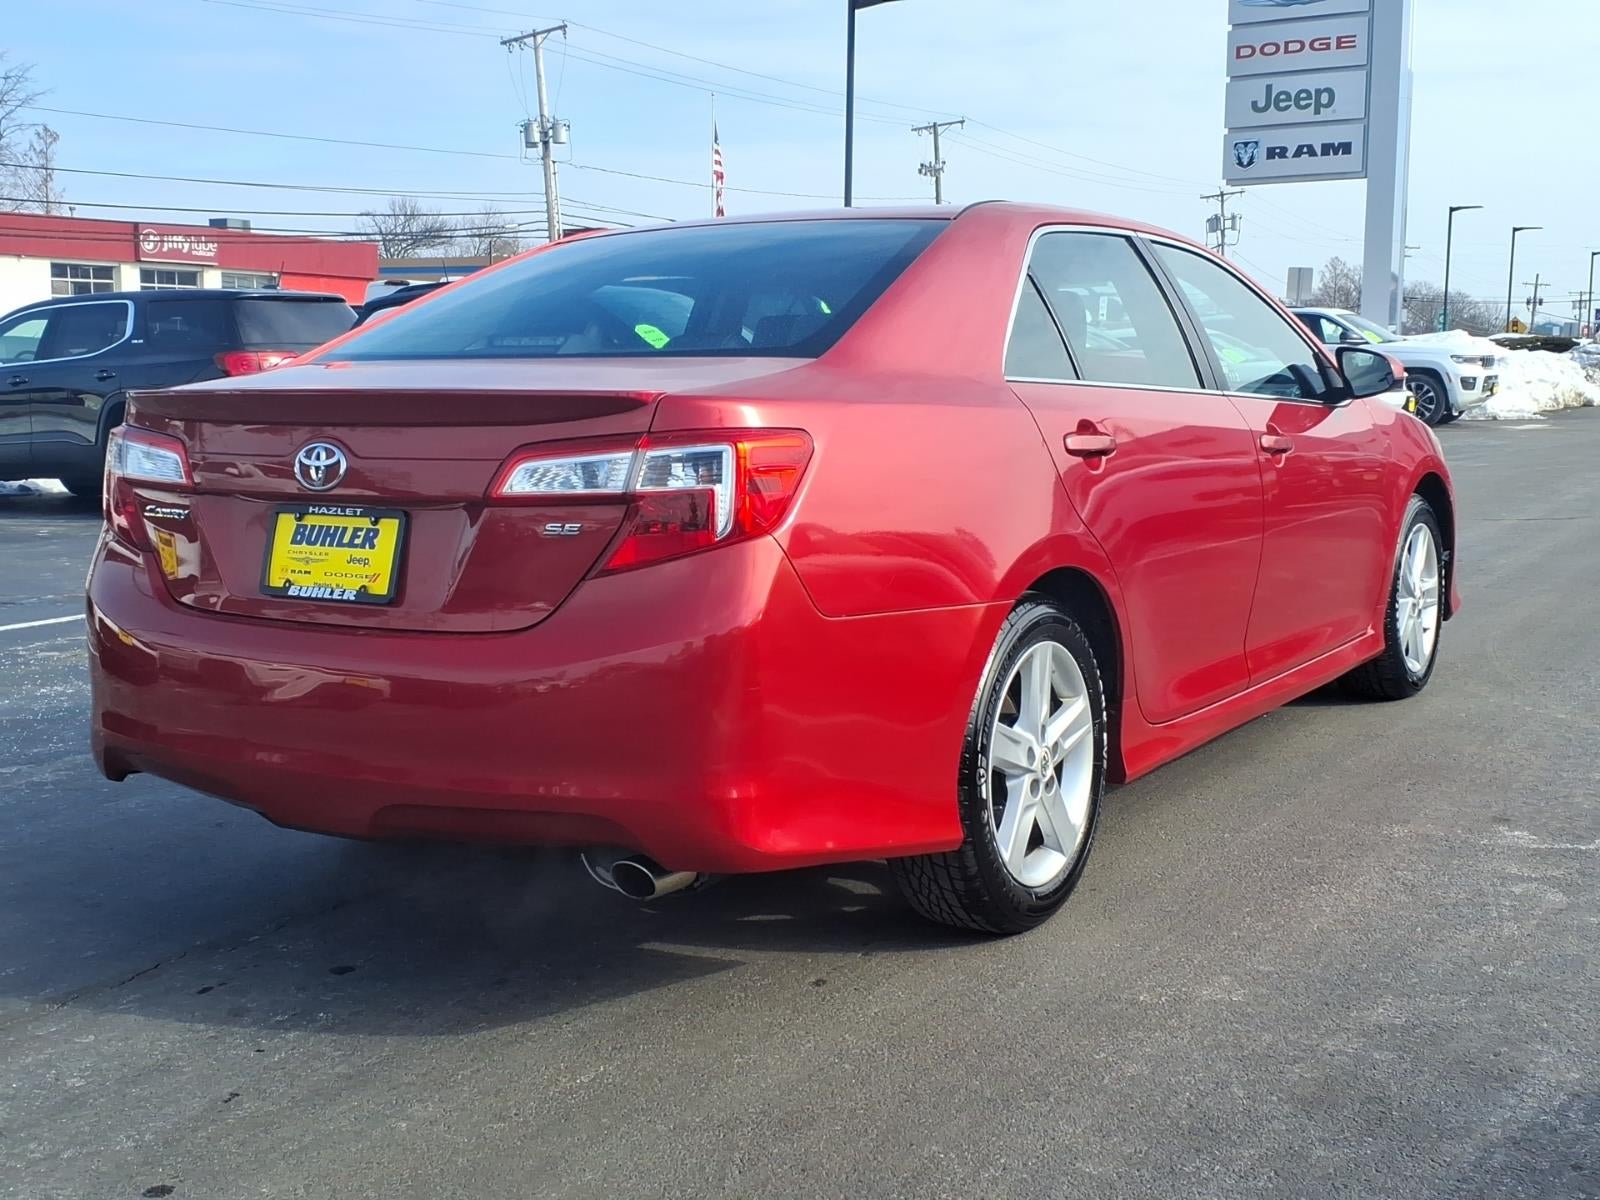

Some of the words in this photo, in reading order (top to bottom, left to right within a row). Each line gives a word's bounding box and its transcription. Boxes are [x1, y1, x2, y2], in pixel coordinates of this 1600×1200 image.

[1235, 34, 1357, 60] DODGE
[1251, 83, 1336, 116] Jeep
[1266, 141, 1353, 160] RAM
[308, 505, 364, 516] HAZLET
[289, 522, 381, 550] BUHLER
[543, 523, 582, 536] SE
[287, 549, 330, 557] CHRYSLER
[346, 554, 370, 567] Jeep
[324, 571, 373, 579] DODGE
[287, 585, 357, 600] BUHLER
